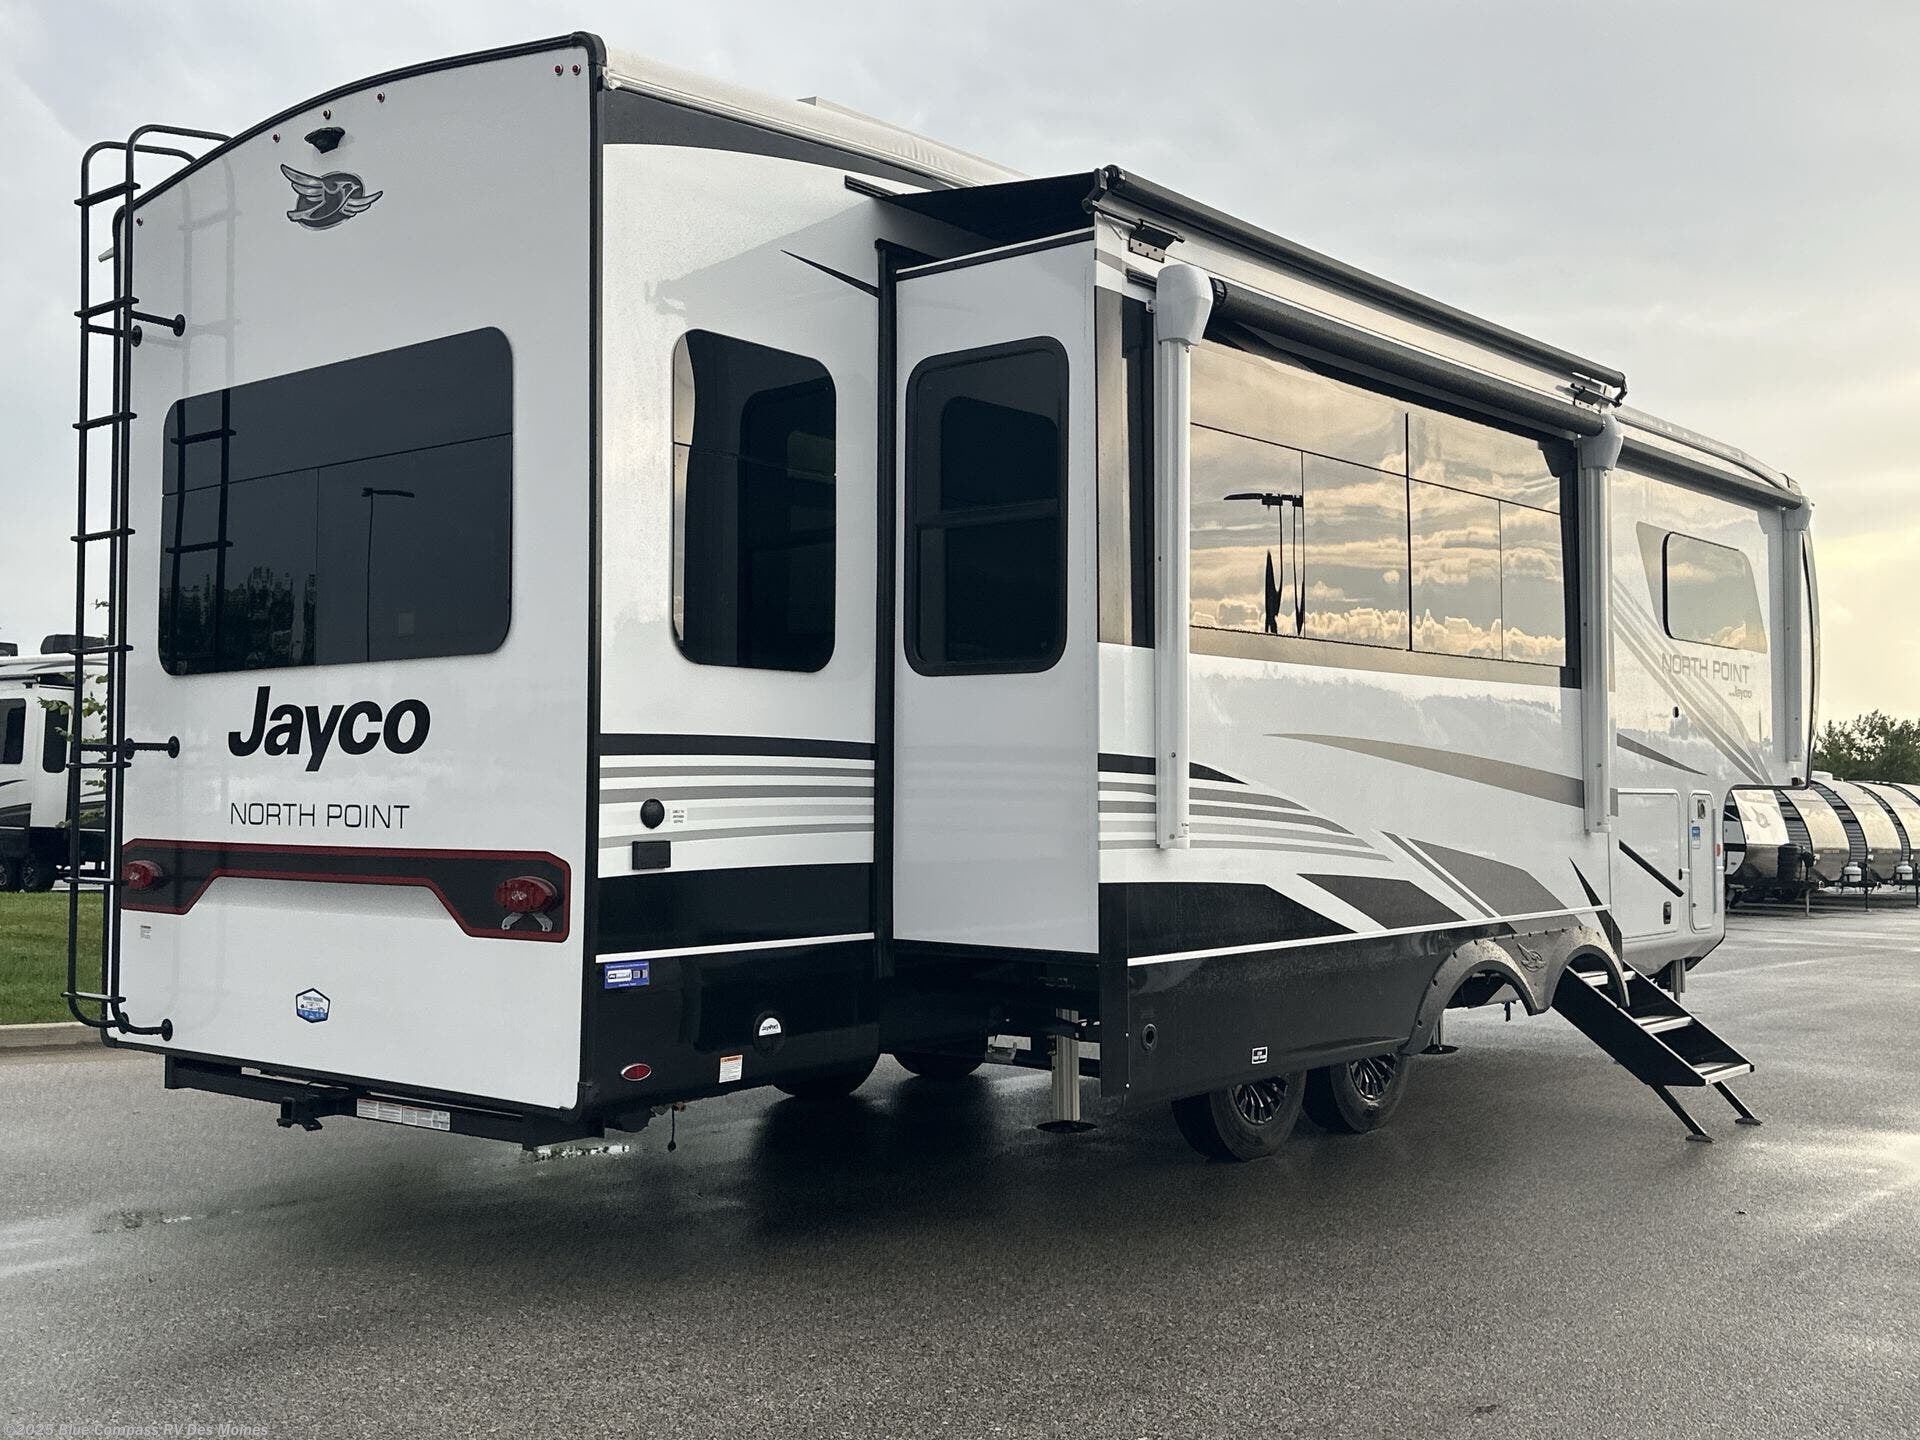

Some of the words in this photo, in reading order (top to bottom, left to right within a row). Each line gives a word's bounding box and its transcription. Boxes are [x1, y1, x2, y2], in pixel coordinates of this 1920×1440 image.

[1661, 653, 1709, 678] NORTH
[1713, 660, 1750, 684] POINT
[228, 685, 431, 772] Jayco
[230, 802, 316, 827] NORTH
[326, 803, 411, 829] POINT
